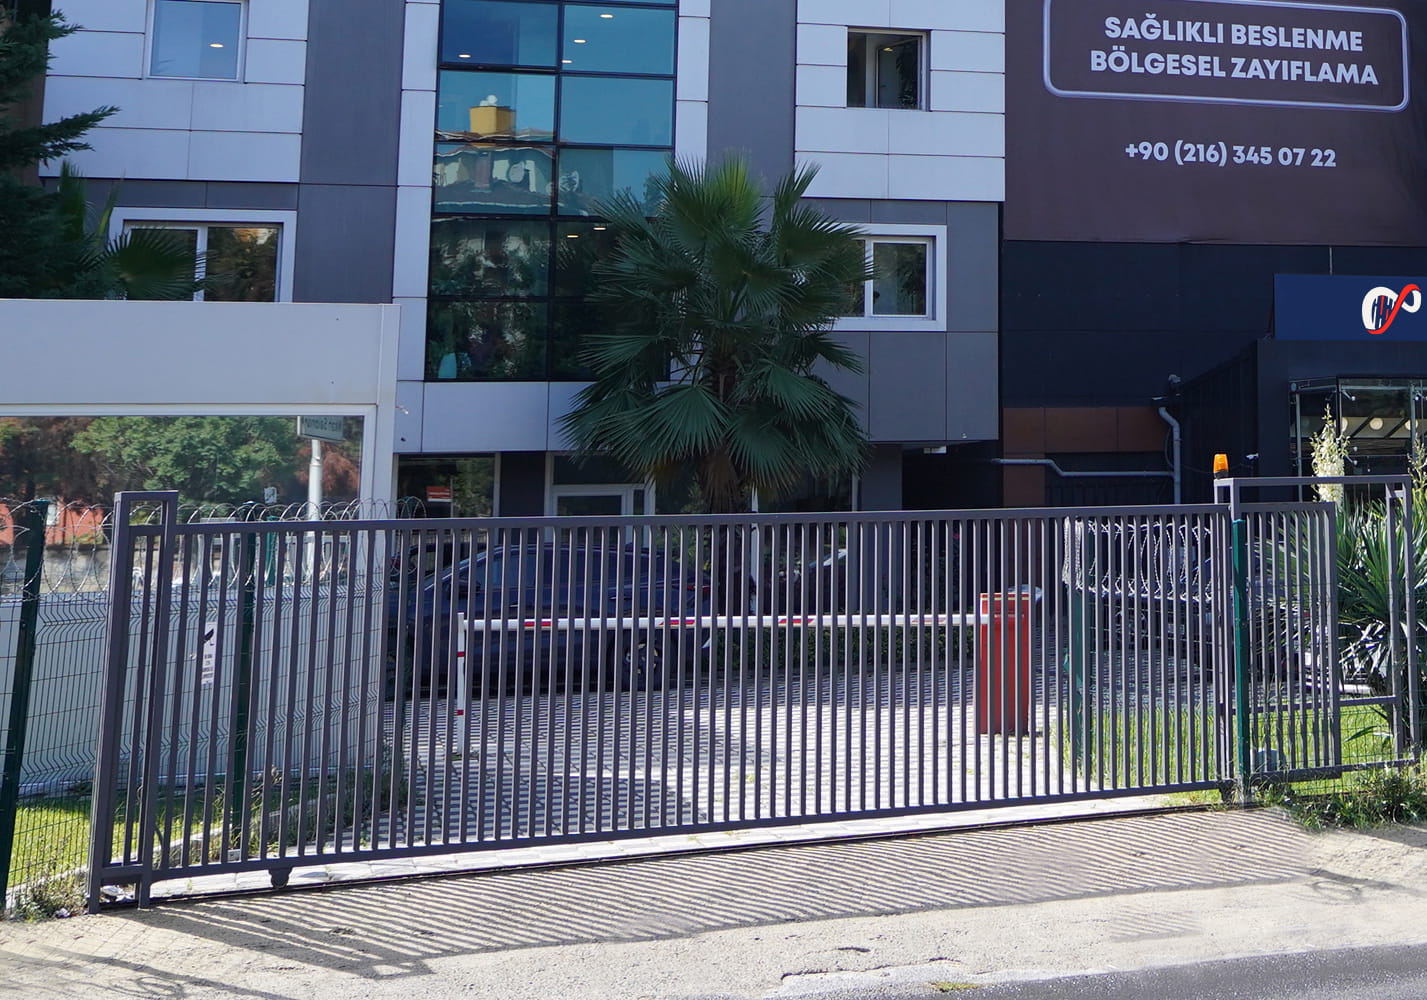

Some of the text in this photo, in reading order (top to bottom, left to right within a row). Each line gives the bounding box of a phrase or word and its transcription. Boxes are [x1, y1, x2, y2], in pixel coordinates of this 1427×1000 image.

[1104, 13, 1363, 52] SAĞLIKLI BESLENME
[1090, 46, 1379, 85] BÖLGESEL ZAYIFLAMA
[1125, 140, 1337, 167] +90 (216) 345 07 22
